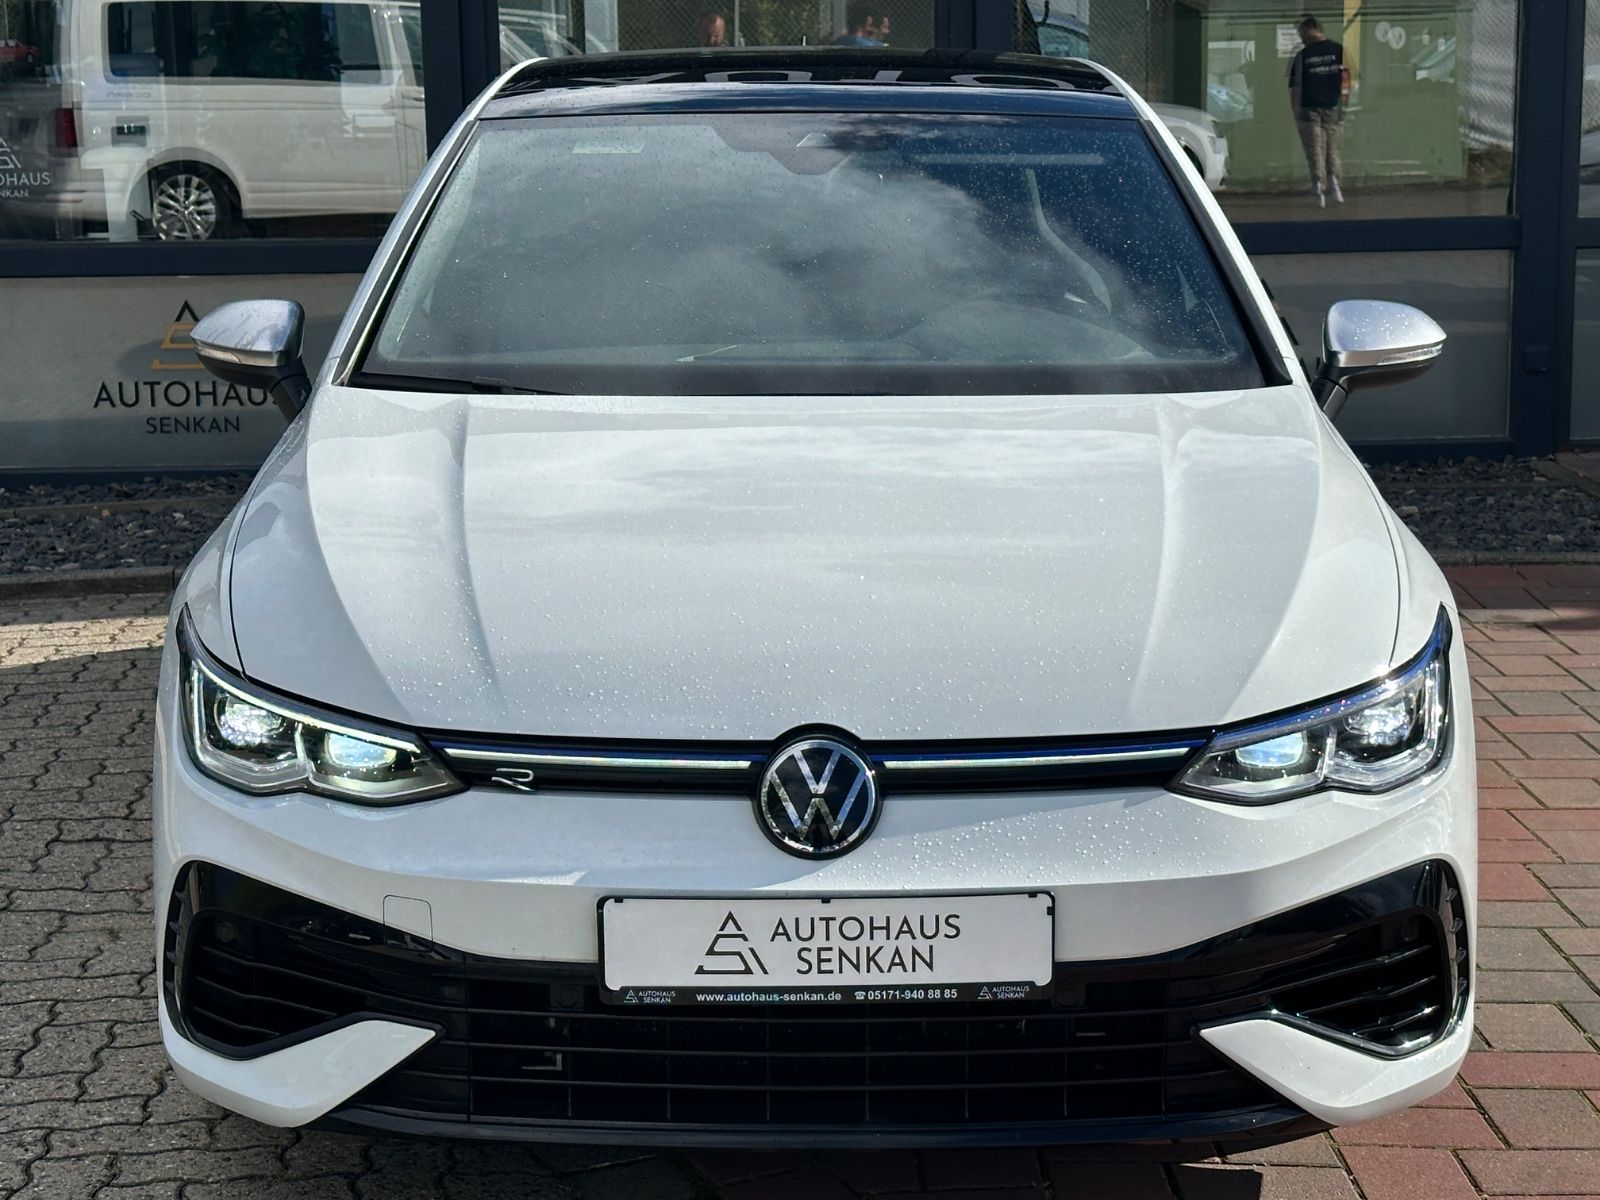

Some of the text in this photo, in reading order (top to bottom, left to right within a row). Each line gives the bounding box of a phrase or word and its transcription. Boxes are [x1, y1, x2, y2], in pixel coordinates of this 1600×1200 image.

[93, 381, 277, 408] AUTOHAU
[146, 416, 240, 434] SENKAN
[491, 767, 535, 791] R
[770, 914, 961, 942] AUTOHAUS
[796, 945, 934, 975] SENKAN
[867, 989, 958, 1000] 05171-940 88 85
[992, 985, 1030, 993] AUTOHAUS
[996, 991, 1026, 999] SENKAN
[642, 996, 671, 1004] SENKAN
[696, 992, 842, 1001] www.autohaus-senkan.de
